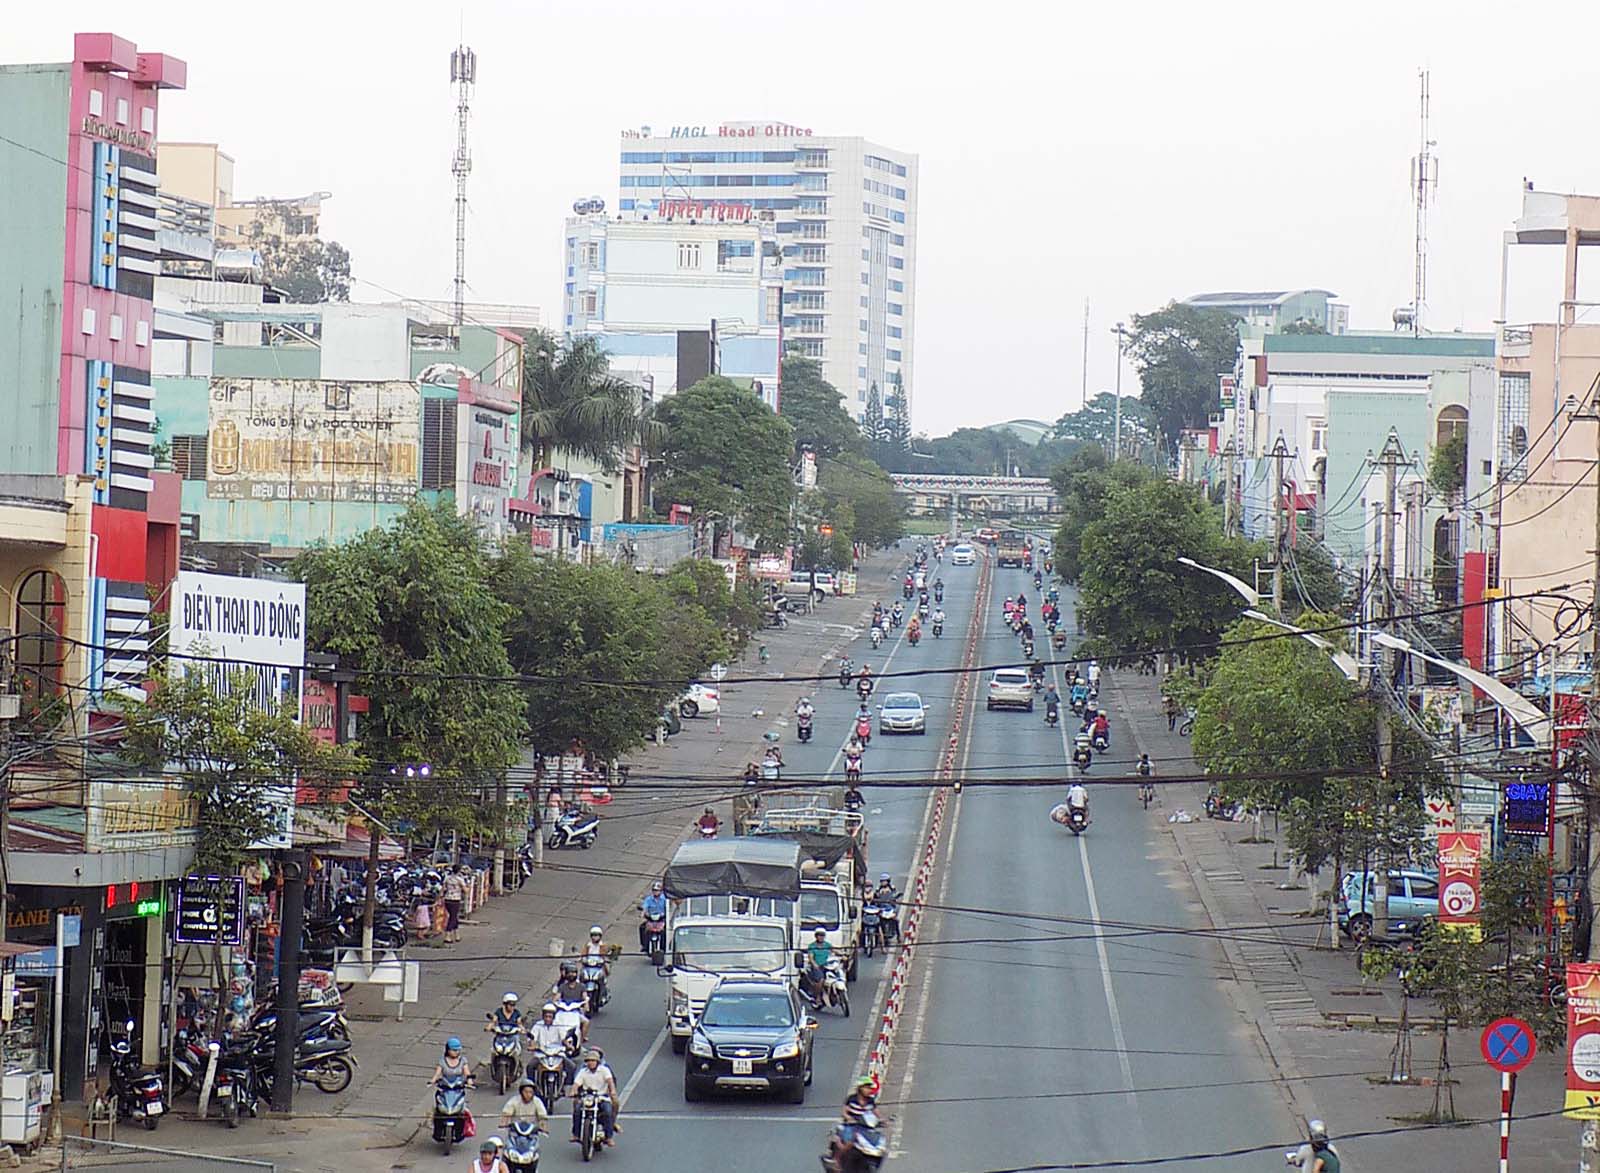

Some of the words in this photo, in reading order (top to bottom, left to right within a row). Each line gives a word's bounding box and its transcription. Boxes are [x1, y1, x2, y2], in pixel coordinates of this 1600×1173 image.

[670, 126, 709, 138] HAGL
[718, 126, 756, 137] Head
[764, 125, 814, 137] Office
[184, 584, 212, 641] ĐIỆN
[215, 595, 250, 643] THOẠI
[253, 599, 265, 637] DI
[269, 592, 300, 647] ĐỘNG
